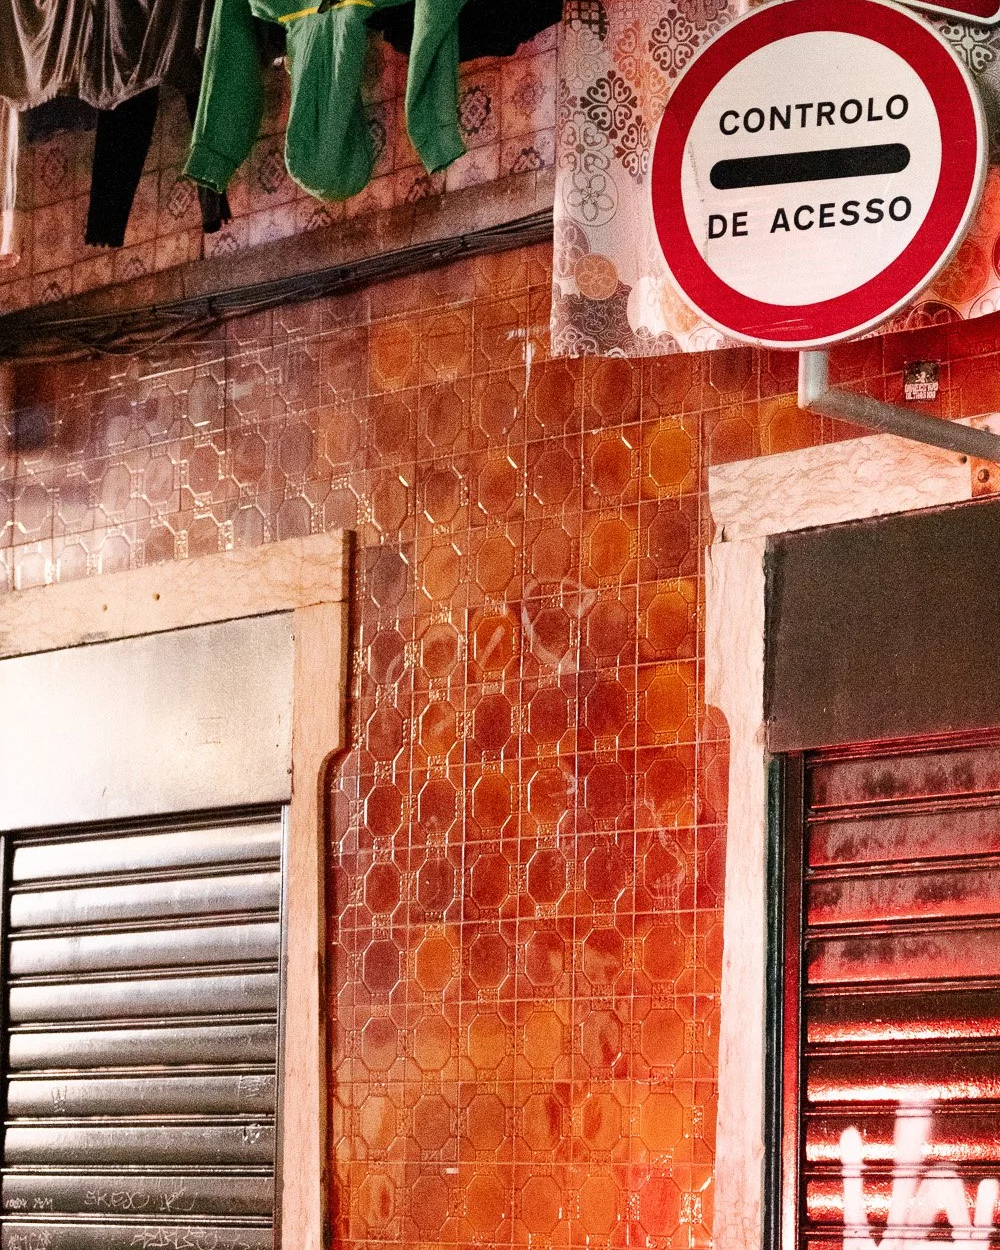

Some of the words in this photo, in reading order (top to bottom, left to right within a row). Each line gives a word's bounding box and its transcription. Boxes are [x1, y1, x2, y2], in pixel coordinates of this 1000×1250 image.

[719, 94, 909, 136] CONTROLO
[708, 211, 748, 239] DE
[770, 196, 912, 234] ACESSO
